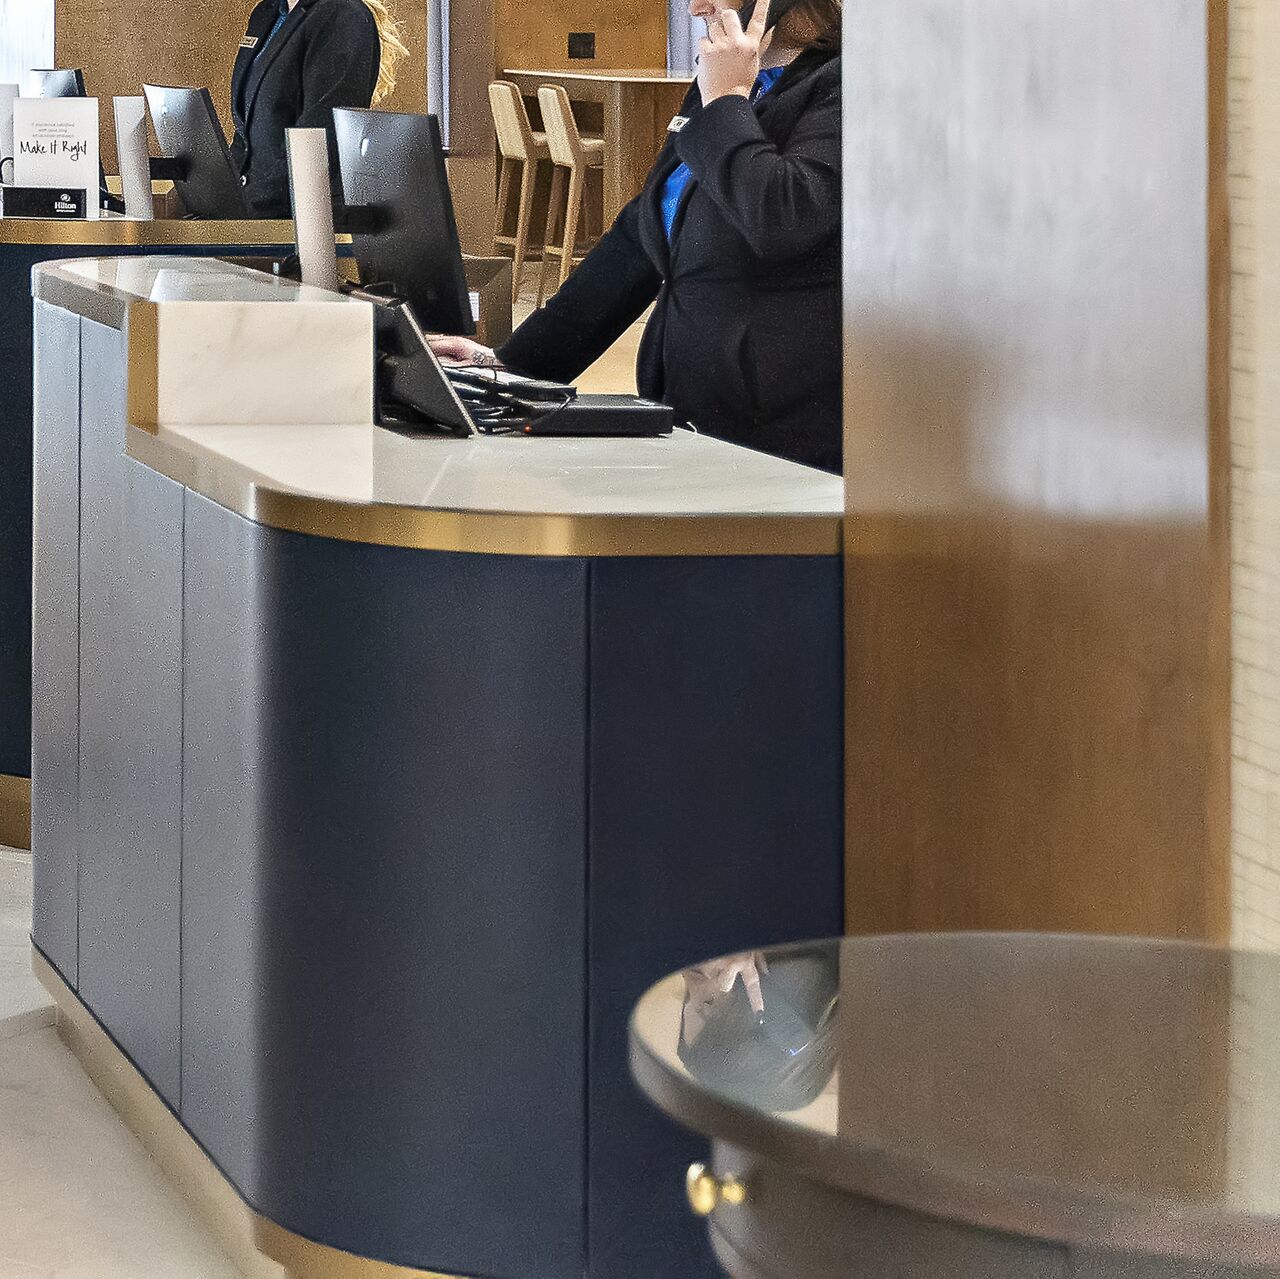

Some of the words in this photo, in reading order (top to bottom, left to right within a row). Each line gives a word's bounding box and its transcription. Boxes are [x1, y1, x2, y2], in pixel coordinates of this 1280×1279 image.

[20, 140, 47, 154] Make
[50, 140, 58, 155] It
[62, 140, 87, 161] Right
[54, 201, 77, 209] Hilton
